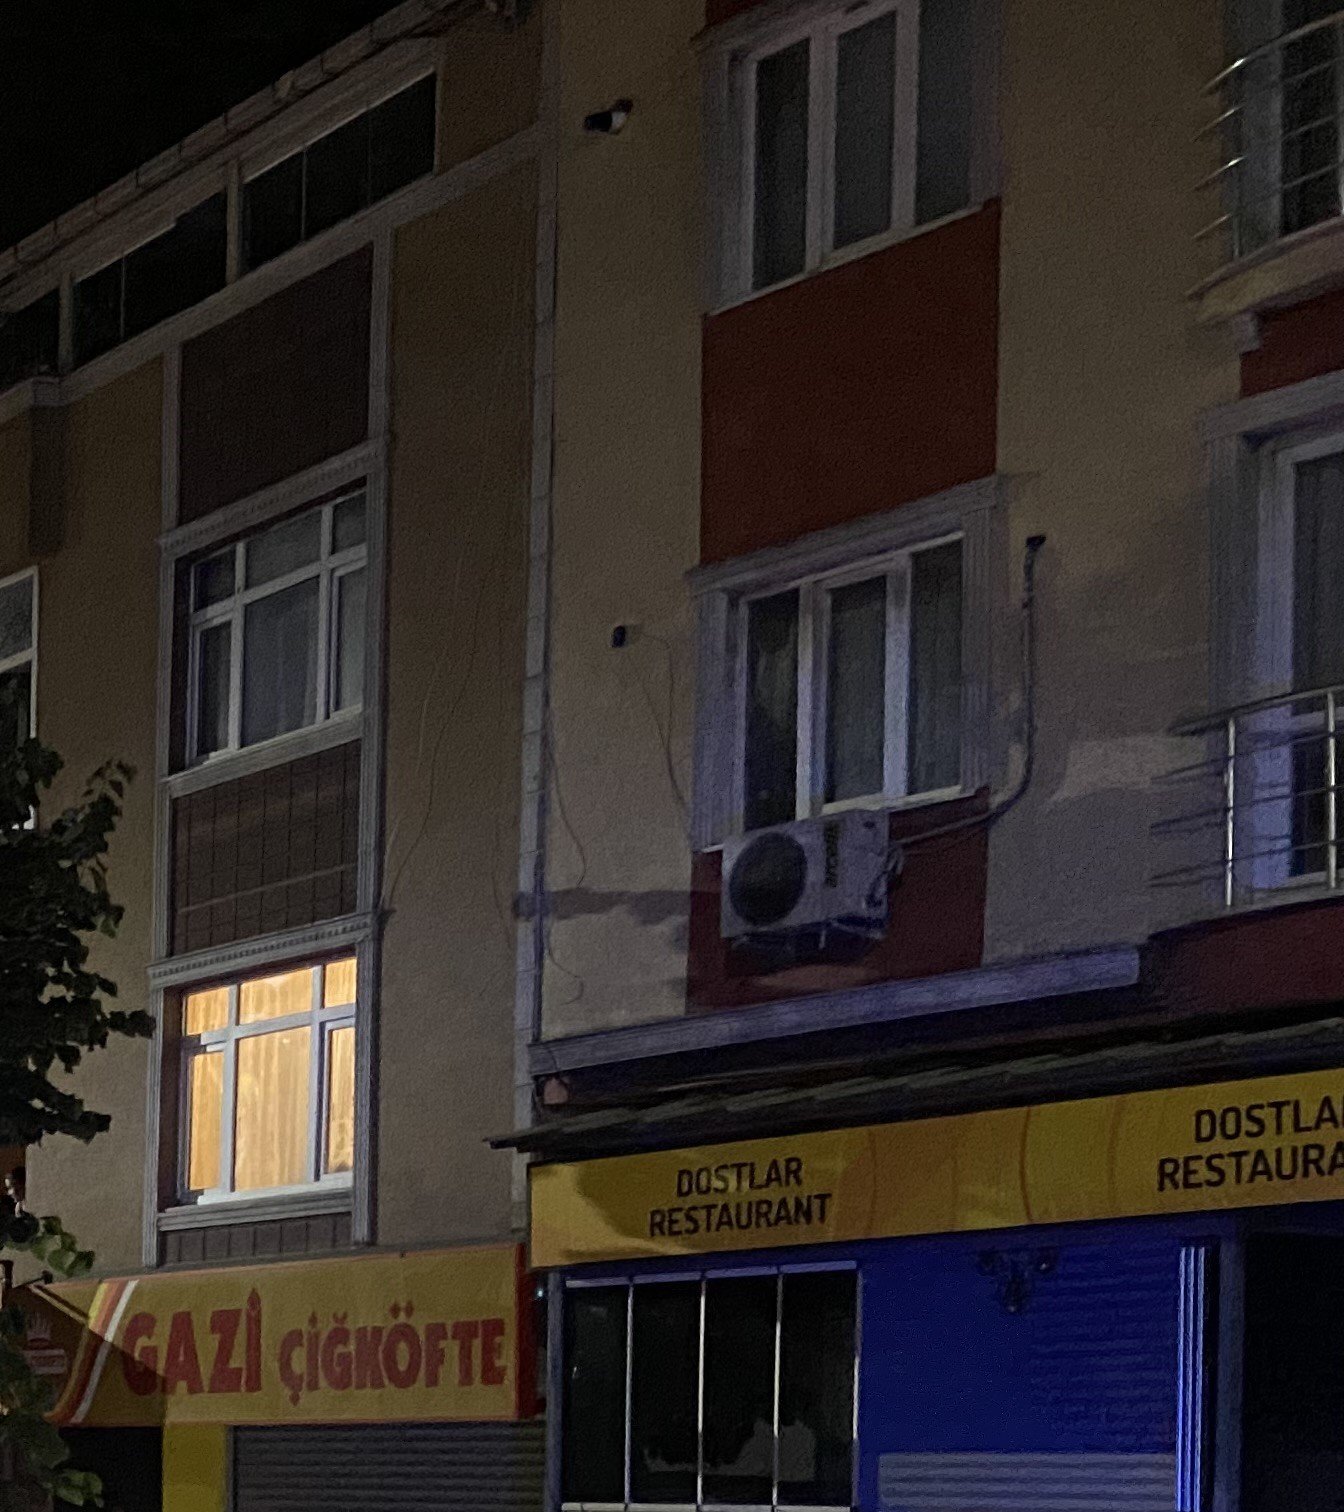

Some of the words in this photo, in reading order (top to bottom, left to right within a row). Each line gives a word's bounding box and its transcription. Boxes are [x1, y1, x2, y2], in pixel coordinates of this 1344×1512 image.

[1195, 1094, 1344, 1143] DOSTLA
[676, 1156, 803, 1198] DOSTLAR
[649, 1192, 832, 1237] RESTAURANT
[122, 1287, 262, 1396] GAZİ
[277, 1300, 508, 1407] ÇİĞKÖFTE
